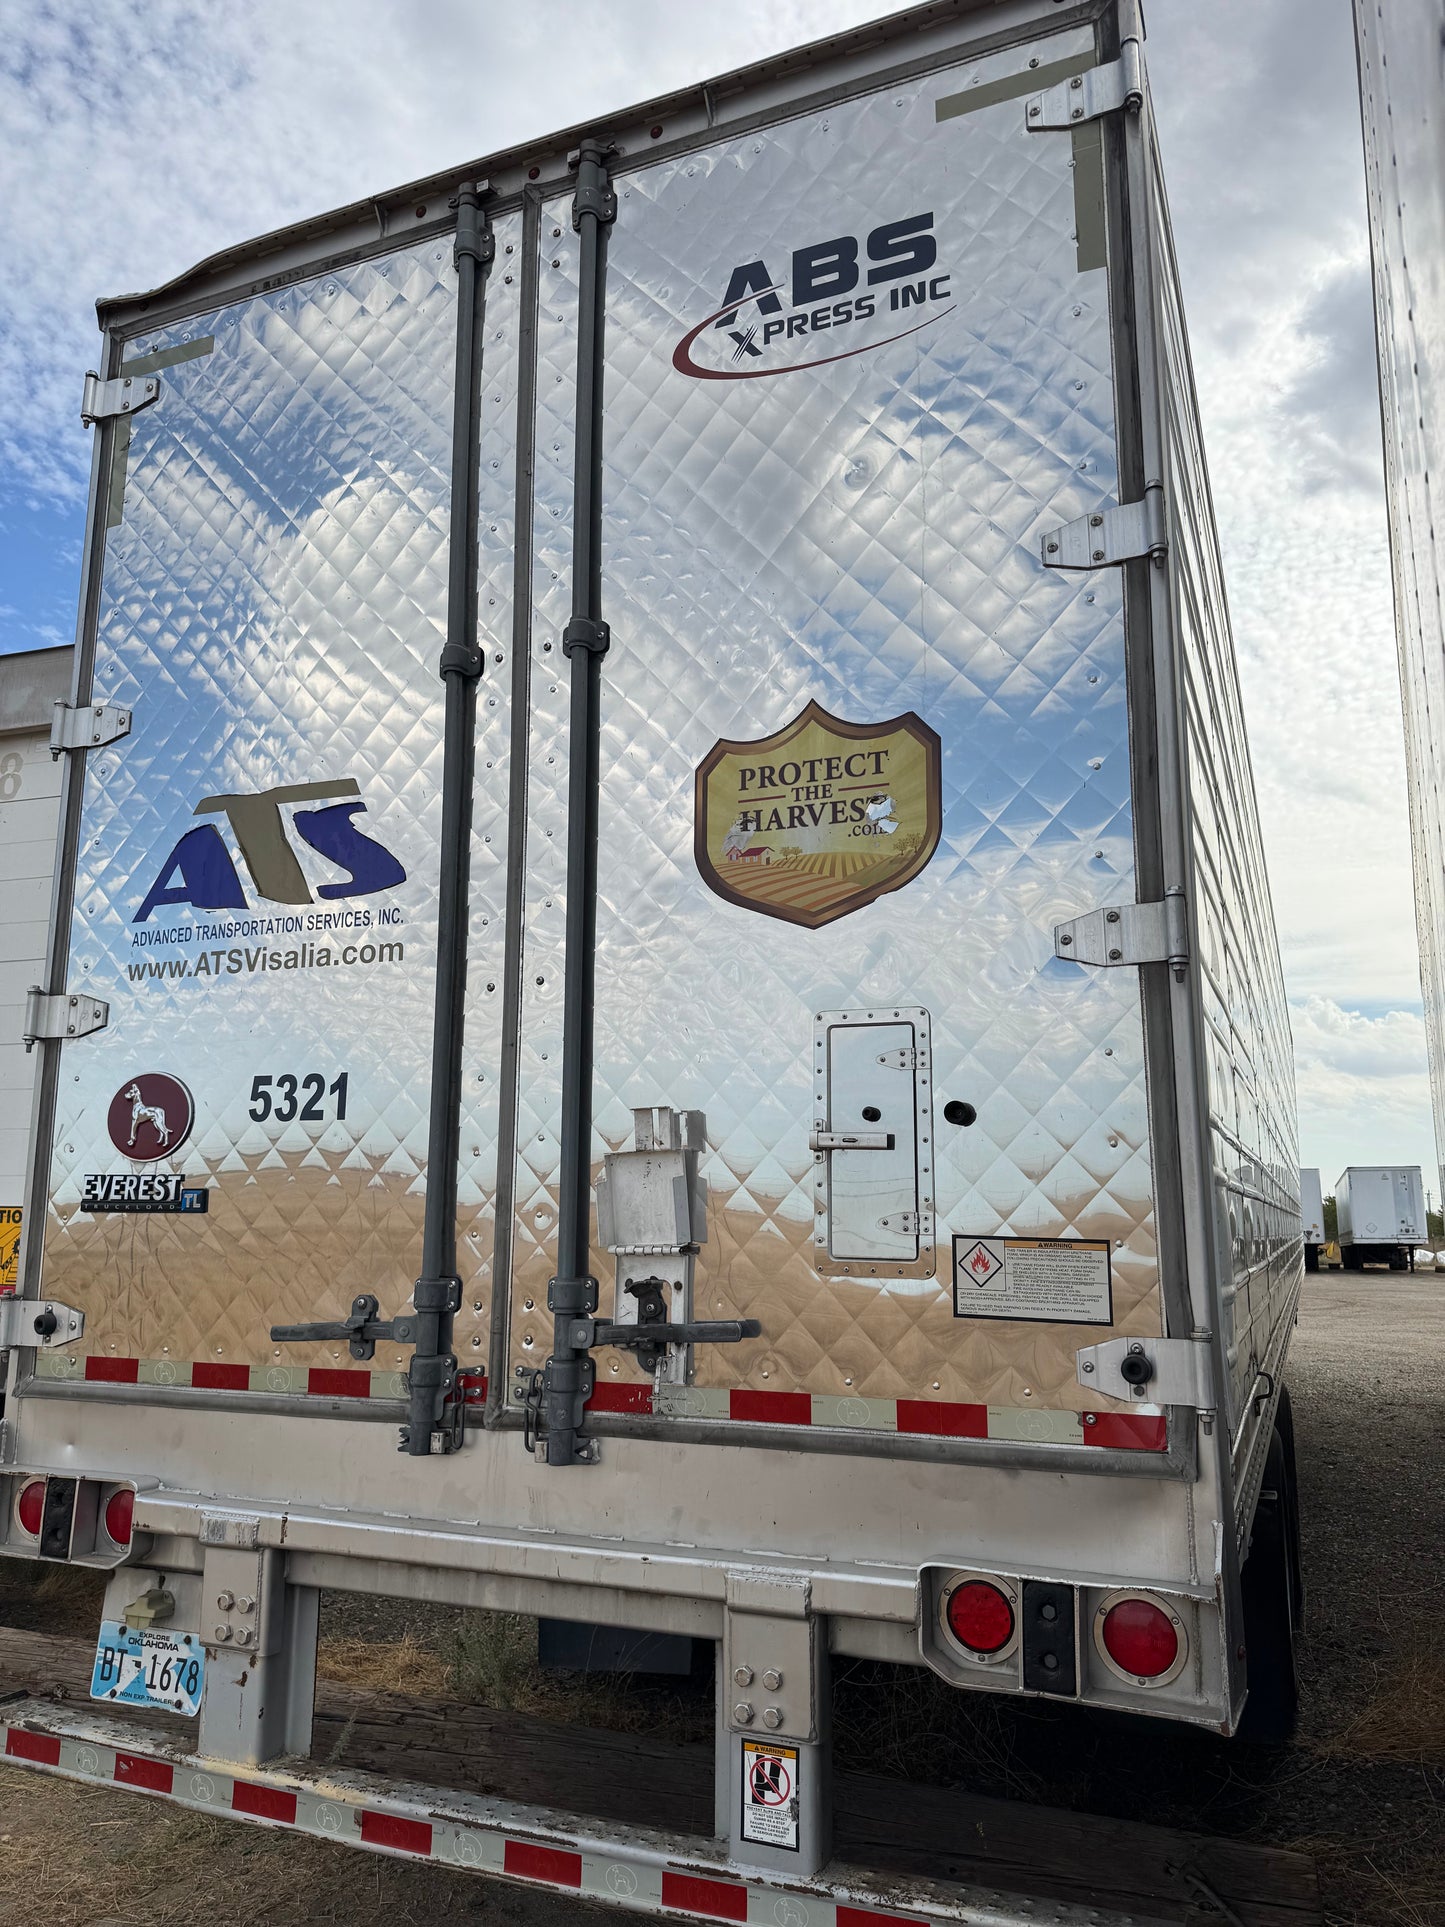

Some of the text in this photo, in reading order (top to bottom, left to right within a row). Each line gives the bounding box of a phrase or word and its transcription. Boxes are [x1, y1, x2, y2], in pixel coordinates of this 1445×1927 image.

[714, 211, 937, 329] ABS
[728, 274, 951, 365] XPRESS INC
[738, 750, 889, 792] PROTECT
[740, 793, 888, 832] HARVES
[791, 784, 833, 803] THE
[132, 778, 406, 923] ATS
[131, 907, 404, 948] ADVANCED TRANSPORTATION SERVICES, INC.
[128, 941, 404, 982] www.ATSVisalia.com
[249, 1072, 349, 1123] 5321
[82, 1175, 181, 1201] EVEREST
[184, 1193, 200, 1208] TL
[128, 1637, 179, 1652] OKLAHOMA
[139, 1632, 170, 1641] EXPLORE
[100, 1646, 199, 1696] BT 1678
[760, 1746, 786, 1756] WARNING
